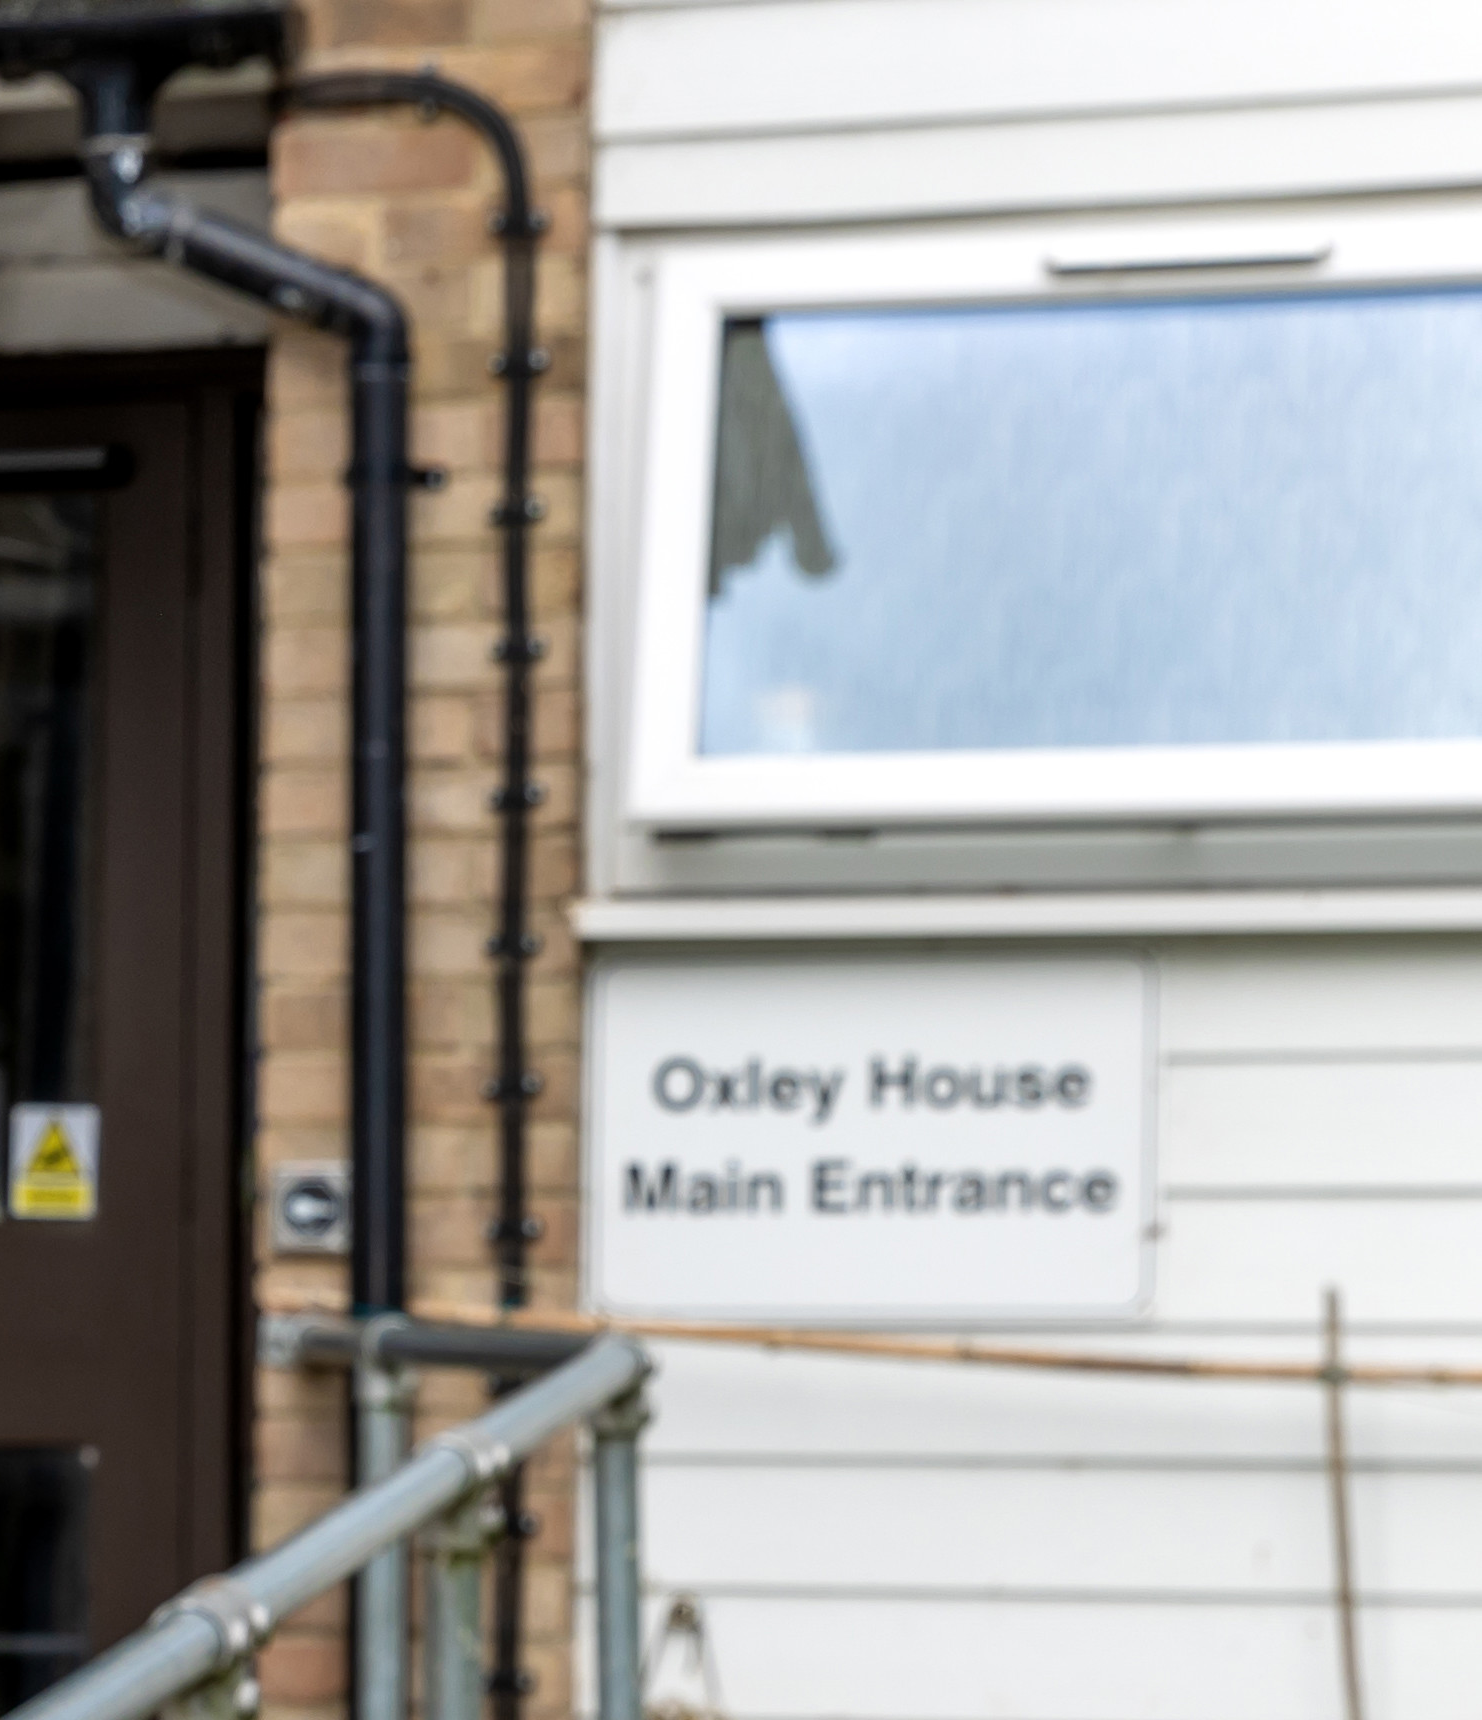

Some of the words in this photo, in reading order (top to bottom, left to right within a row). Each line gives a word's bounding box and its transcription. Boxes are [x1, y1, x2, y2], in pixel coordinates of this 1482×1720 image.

[651, 1054, 843, 1124] Oxley
[868, 1054, 1092, 1111] House
[624, 1158, 784, 1213] Main
[810, 1158, 1118, 1214] Entrance
